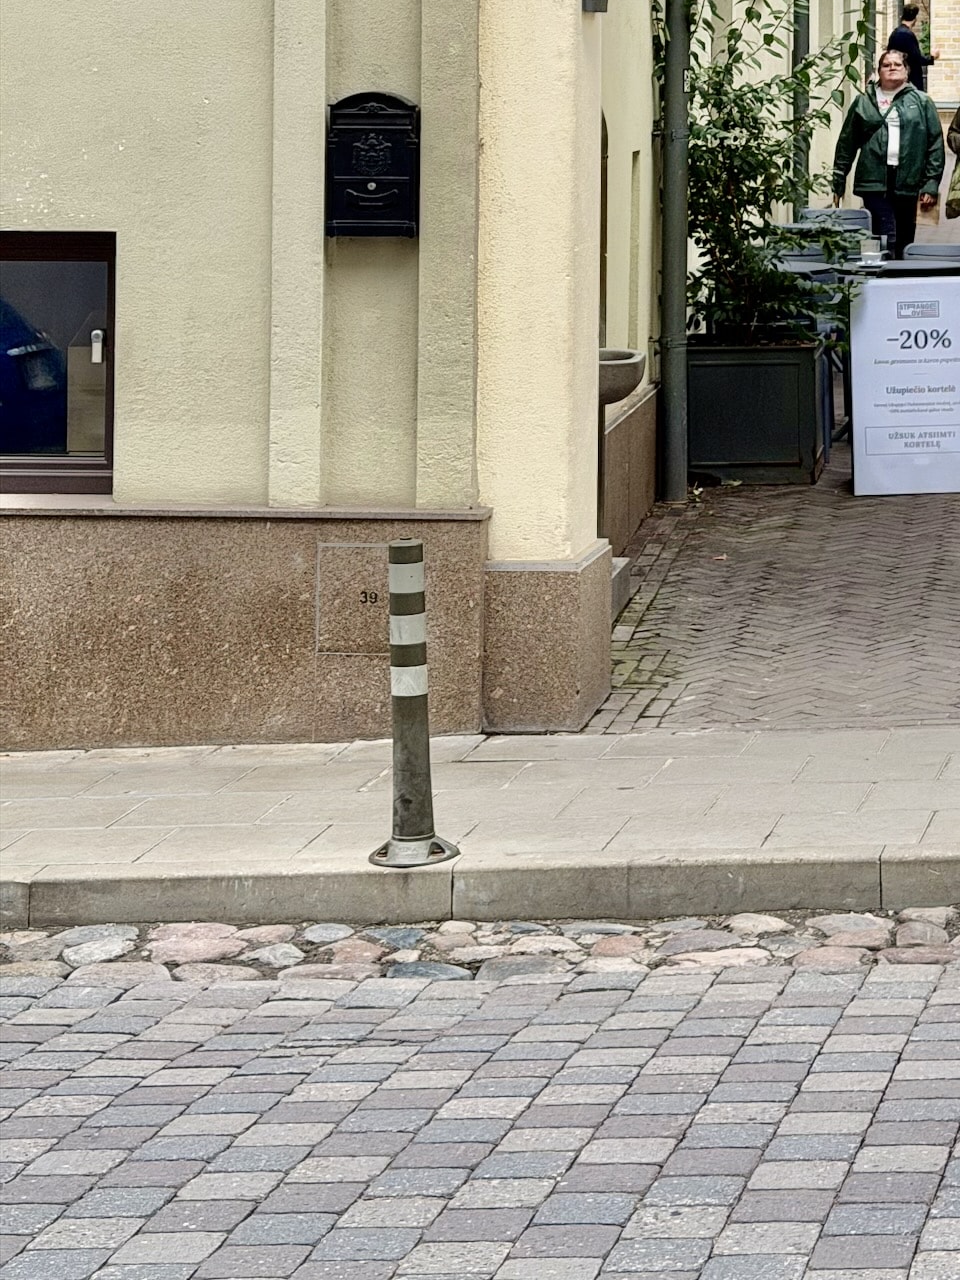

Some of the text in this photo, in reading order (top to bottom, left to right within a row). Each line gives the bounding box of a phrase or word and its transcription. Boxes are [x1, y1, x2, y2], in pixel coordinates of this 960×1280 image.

[899, 303, 937, 311] STRANGE
[888, 432, 916, 440] UŽSUK
[360, 591, 377, 604] 39
